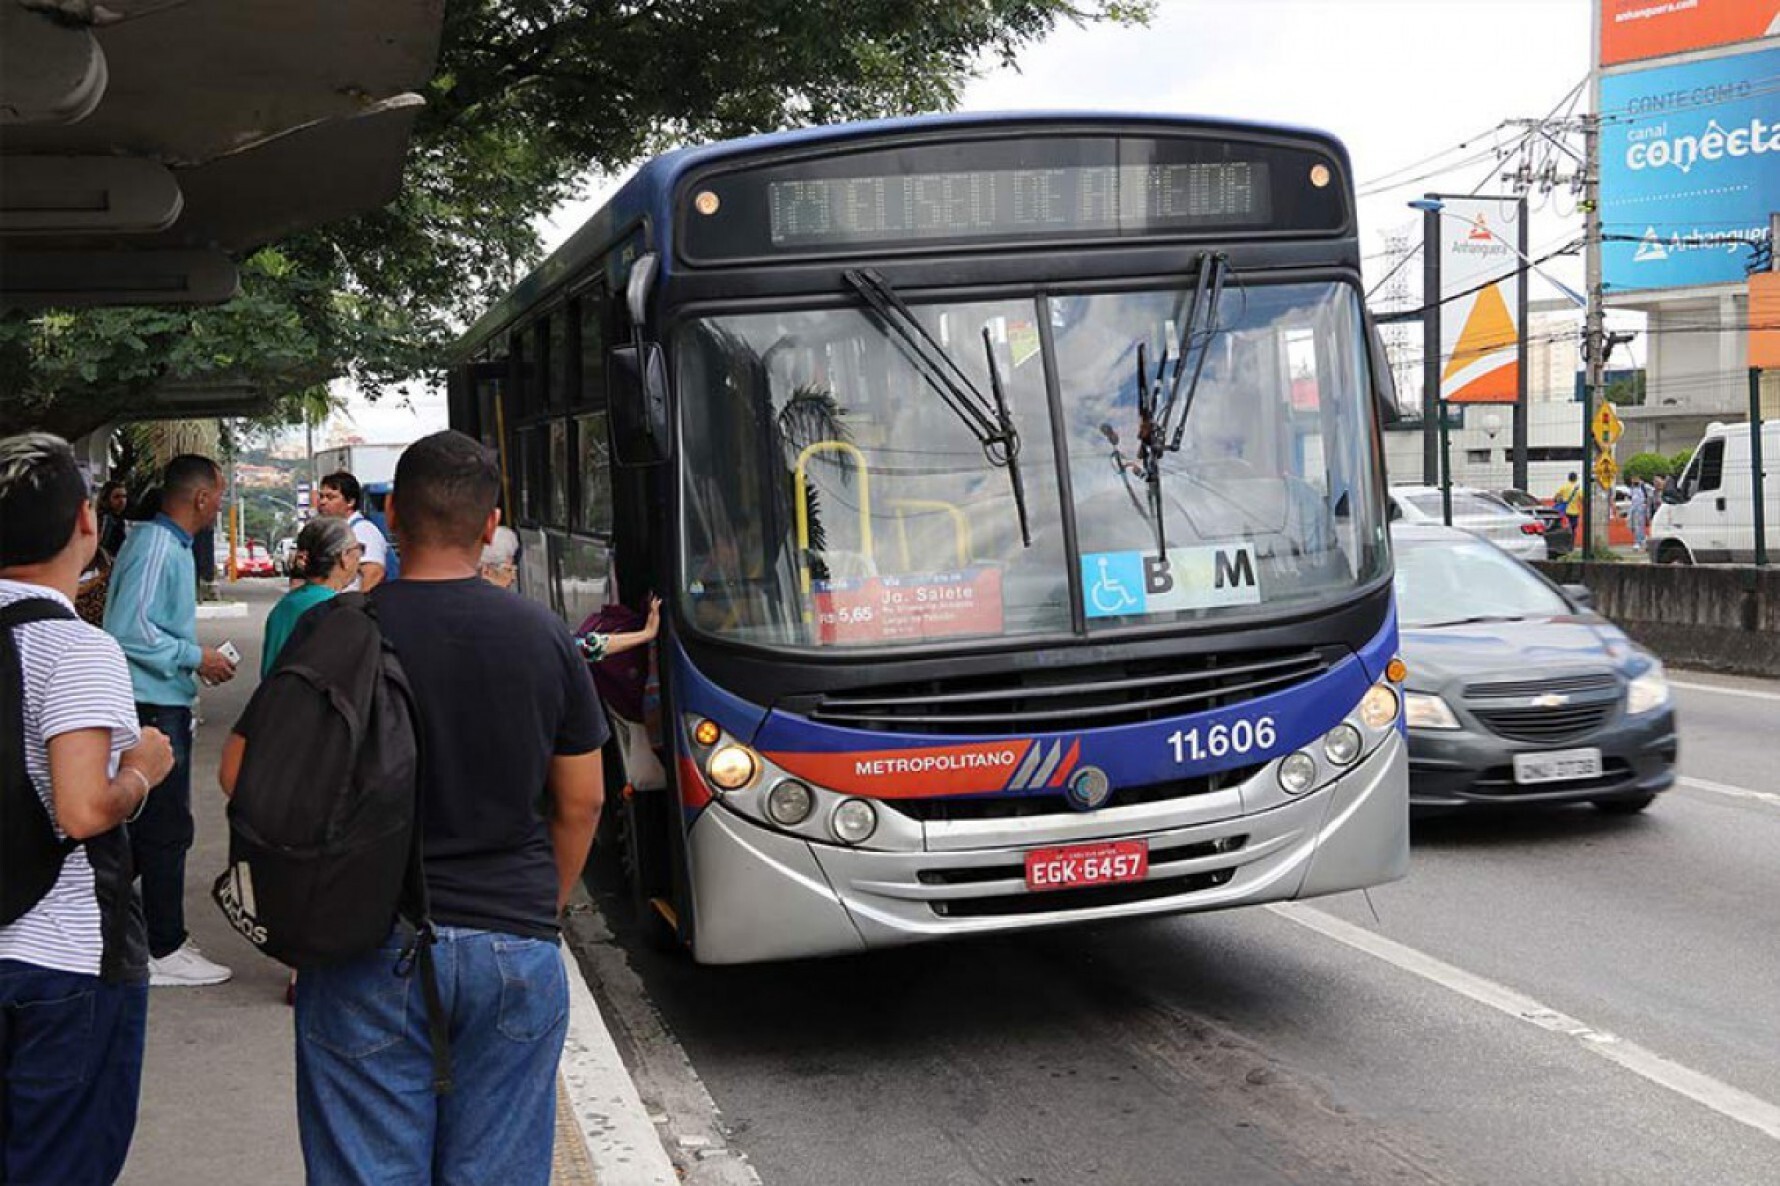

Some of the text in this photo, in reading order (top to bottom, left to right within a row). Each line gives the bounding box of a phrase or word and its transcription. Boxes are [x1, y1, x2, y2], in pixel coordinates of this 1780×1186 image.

[1626, 122, 1667, 141] canal
[838, 605, 873, 625] 5,65
[1167, 715, 1277, 764] 11.606
[855, 750, 1016, 776] METROPOLITANO
